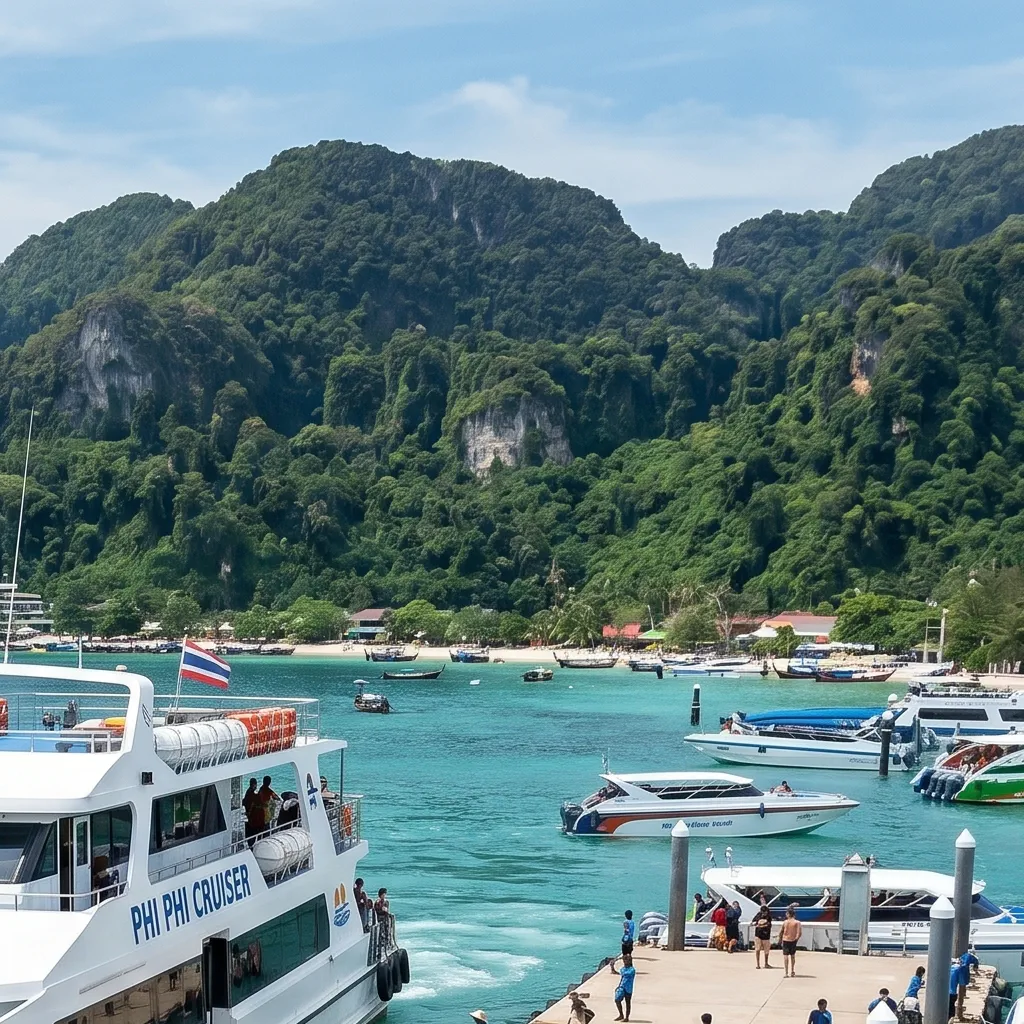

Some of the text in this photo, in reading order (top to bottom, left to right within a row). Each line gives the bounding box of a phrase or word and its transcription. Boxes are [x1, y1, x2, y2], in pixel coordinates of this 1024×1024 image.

[130, 863, 252, 946] PHI PHI CRUISER
